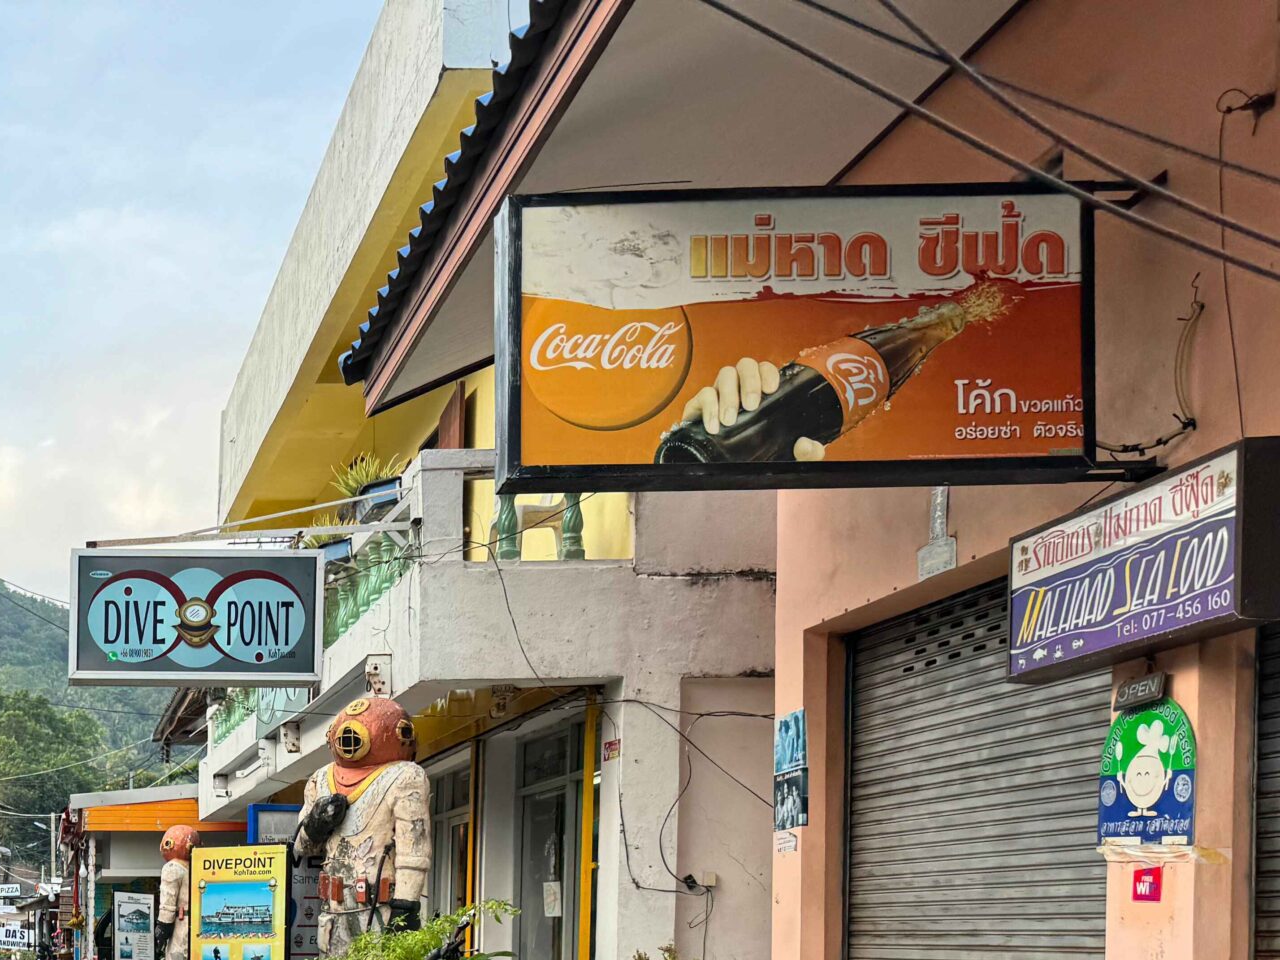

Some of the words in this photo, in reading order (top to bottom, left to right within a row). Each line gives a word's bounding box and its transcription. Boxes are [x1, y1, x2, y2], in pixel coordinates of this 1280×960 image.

[690, 214, 888, 279] แม่หาด
[530, 321, 685, 371] Coca-Cola
[1016, 566, 1116, 647] MAEHAAD
[1113, 550, 1167, 616] SEA
[1166, 526, 1230, 600] FOOD
[226, 600, 295, 646] POINT
[1116, 622, 1138, 638] Tel:
[1142, 599, 1202, 631] 077-456
[1208, 589, 1231, 611] 160
[1117, 676, 1158, 702] OPEN
[1101, 727, 1123, 773] Clean
[1175, 718, 1193, 767] Taste
[4, 928, 26, 940] DA'S
